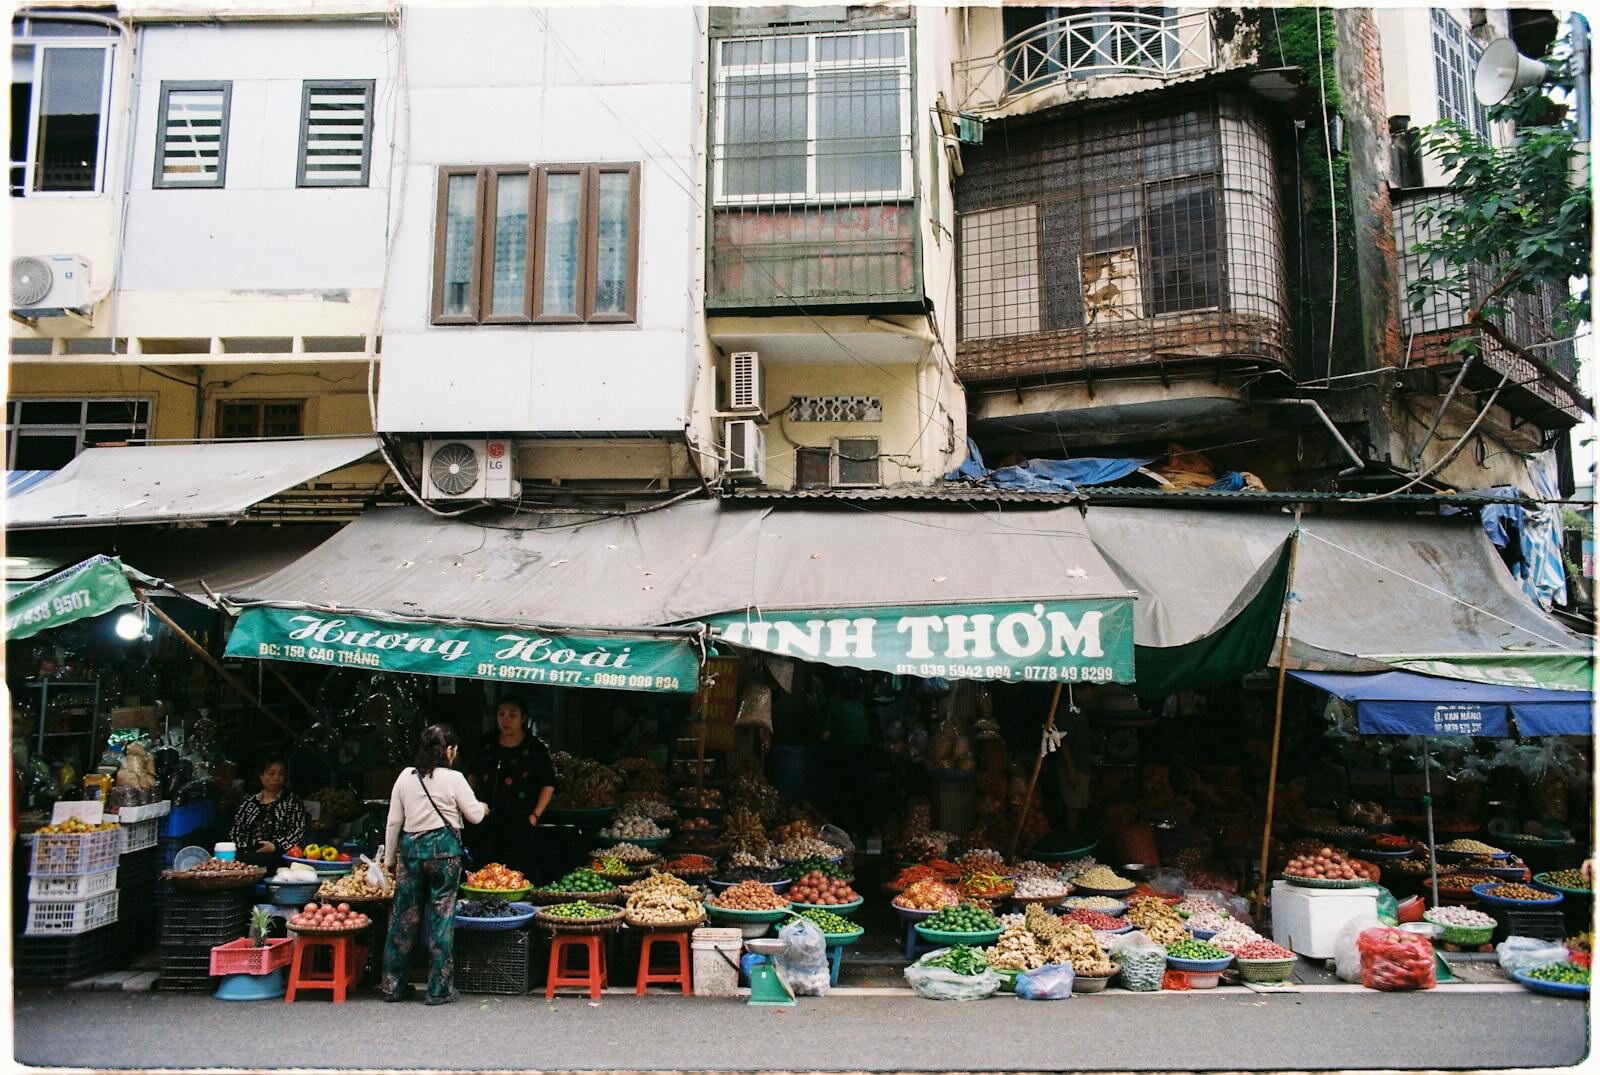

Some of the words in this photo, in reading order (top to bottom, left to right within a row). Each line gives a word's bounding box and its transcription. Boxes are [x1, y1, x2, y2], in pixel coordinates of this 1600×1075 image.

[489, 461, 503, 470] LG
[52, 589, 91, 615] 9507
[896, 603, 1105, 659] THƠM
[288, 615, 473, 661] Hương
[495, 634, 633, 669] Hoài
[307, 646, 334, 662] CAO
[499, 665, 545, 681] 097771
[549, 668, 583, 684] 6177
[919, 664, 946, 677] 039
[948, 664, 985, 678] 5942
[1024, 665, 1057, 680] 0778
[1060, 666, 1078, 681] 49
[1081, 666, 1113, 681] 8299
